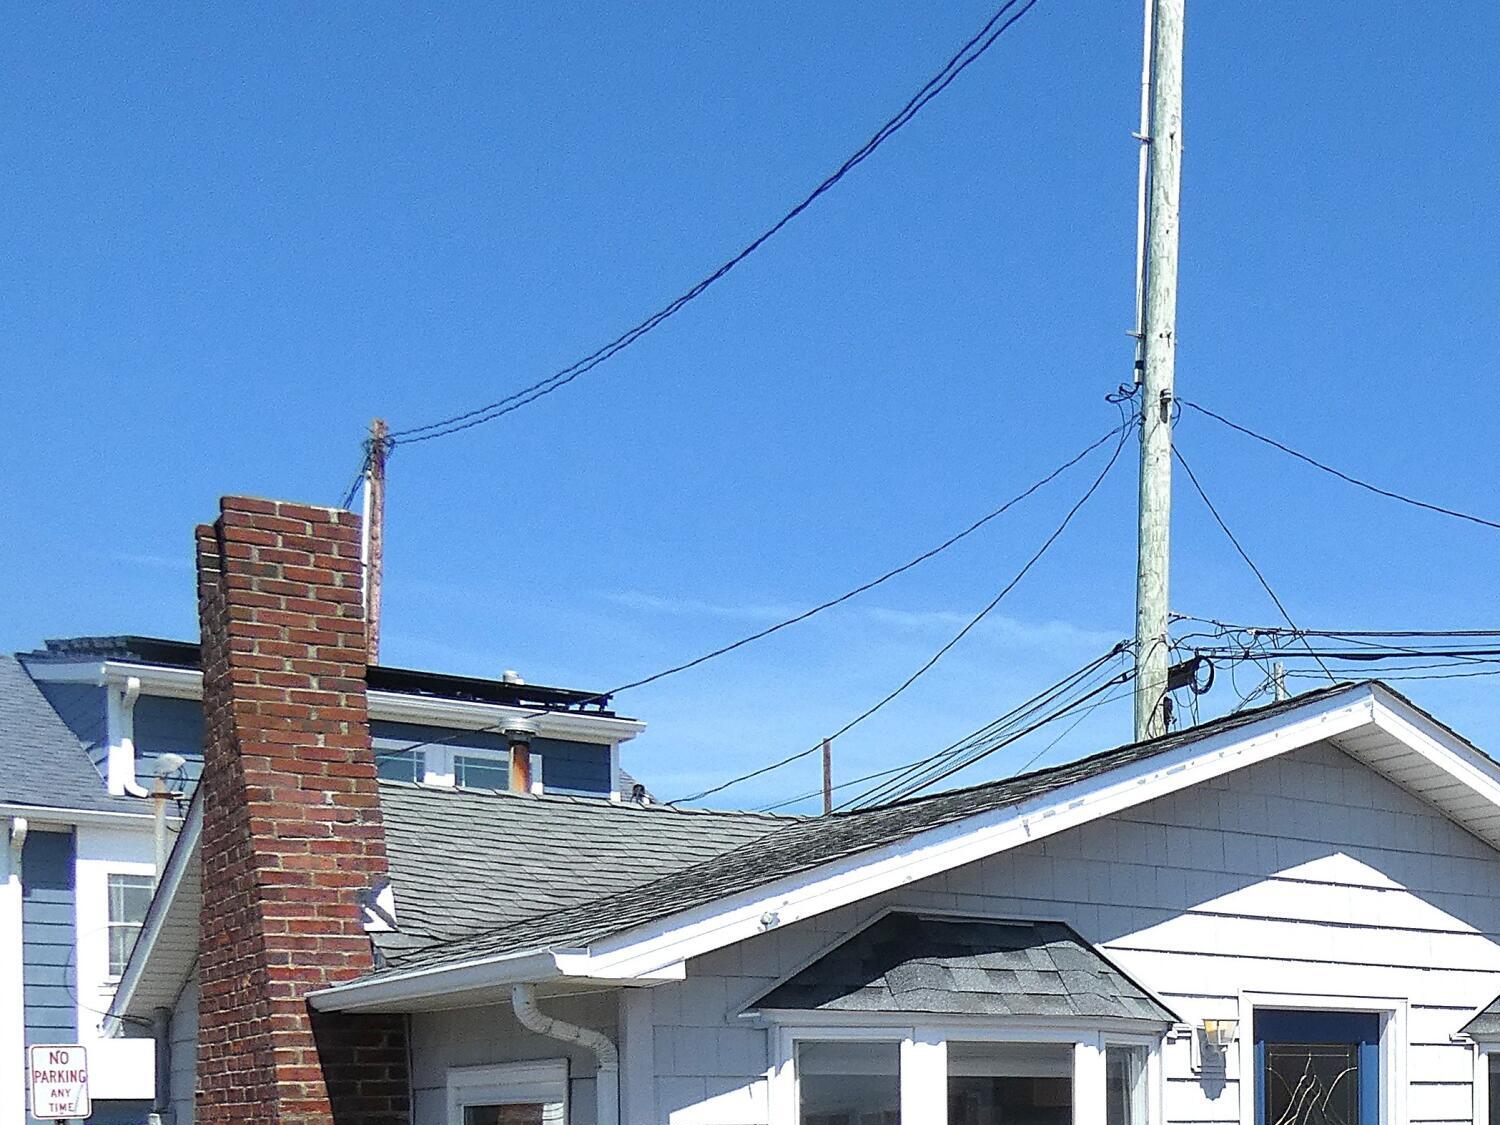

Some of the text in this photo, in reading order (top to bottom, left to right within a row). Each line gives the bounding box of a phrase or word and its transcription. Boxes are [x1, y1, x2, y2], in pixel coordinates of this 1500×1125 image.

[49, 1051, 69, 1065] NO
[34, 1070, 86, 1083] PARKING
[51, 1089, 71, 1098] ANY
[49, 1102, 74, 1112] TIME
